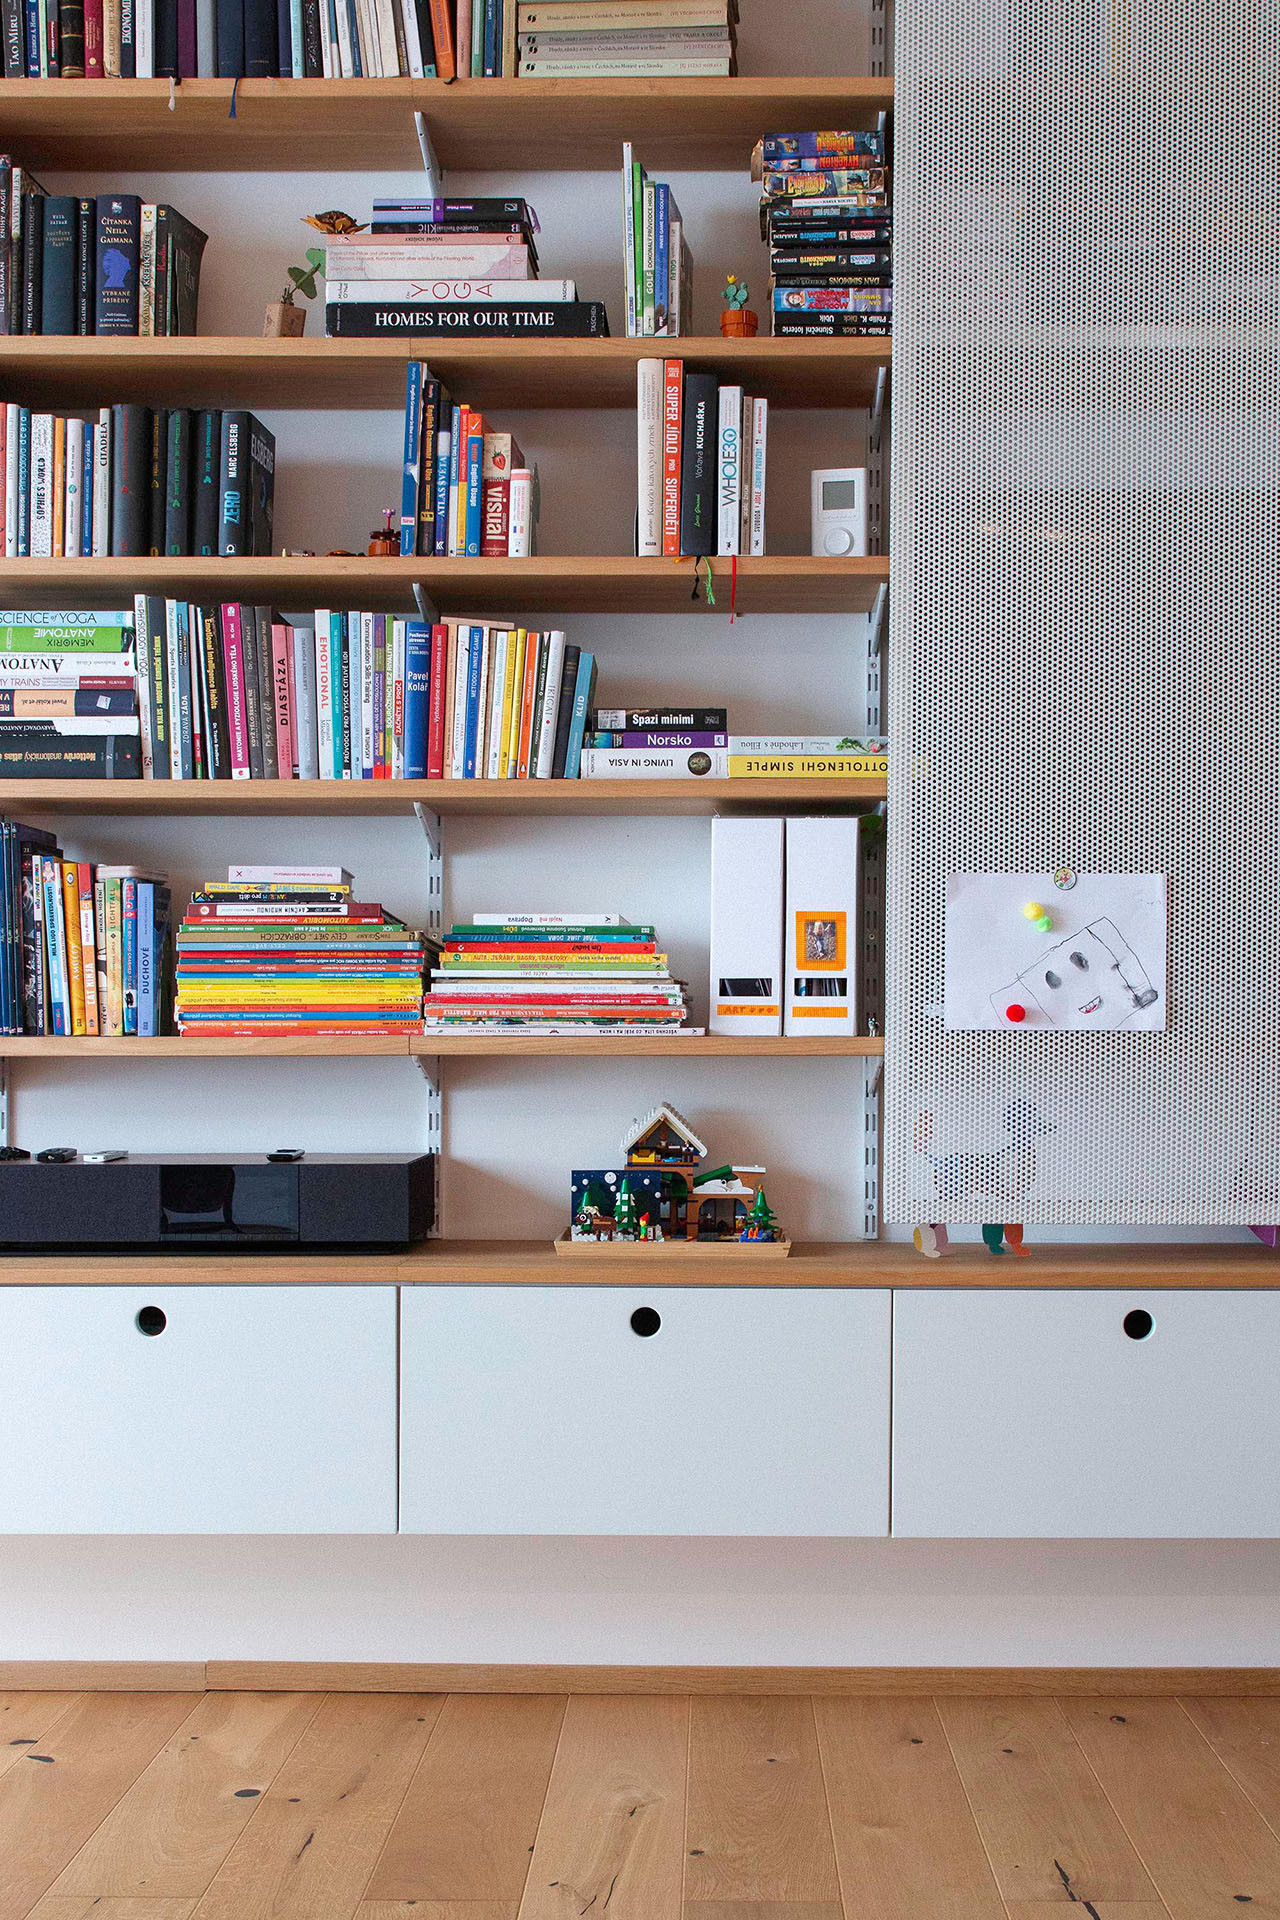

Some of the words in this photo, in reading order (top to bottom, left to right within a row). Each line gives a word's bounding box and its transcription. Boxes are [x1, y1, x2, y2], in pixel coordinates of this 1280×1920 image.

[8, 15, 18, 43] MÍRU
[10, 46, 19, 67] TAO
[101, 216, 132, 226] ČÍTANKA
[100, 236, 133, 244] GAIMANA
[83, 262, 87, 270] NA
[829, 277, 863, 285] SIMMONS
[864, 277, 880, 285] DAN
[411, 282, 493, 300] YOGA
[374, 312, 434, 327] HOMES
[438, 312, 469, 326] FOR
[474, 312, 509, 326] OUR
[512, 312, 554, 326] TIME
[782, 326, 804, 334] loterie
[806, 326, 833, 334] Sluneční
[868, 327, 885, 335] Philip
[666, 386, 679, 421] SUPER
[426, 405, 434, 428] English
[697, 401, 705, 449] KUCHAŘKA
[229, 424, 238, 455] ELSBERG
[425, 430, 434, 459] Grammar
[665, 424, 679, 453] JÍDLO
[229, 456, 237, 478] MARC
[439, 457, 447, 486] SVĚTA
[647, 449, 657, 487] kávových
[668, 459, 676, 471] PRO
[723, 428, 737, 506] WHOLE30
[425, 469, 433, 481] Use
[470, 464, 479, 486] English
[470, 488, 479, 507] Usage
[647, 489, 655, 516] Kouzlo
[665, 478, 679, 535] SUPERDĚTI
[224, 491, 241, 524] ZERO
[486, 486, 507, 540] visual
[0, 613, 49, 624] SCIENCE
[59, 613, 98, 624] YOGA
[33, 628, 96, 638] ANATOMIE
[138, 610, 146, 652] PHYSIOLOGY
[205, 618, 214, 651] Emotional
[47, 639, 95, 647] MEMORIX
[139, 656, 148, 678] YOGA
[207, 652, 216, 688] Intelligence
[231, 661, 239, 690] LIDSKÉHO
[319, 637, 329, 709] EMOTIONAL
[409, 671, 428, 680] Pavel
[10, 678, 40, 687] TRAINS
[277, 657, 288, 726] DIASTÁZA
[408, 682, 428, 691] Kolář
[209, 689, 217, 710] Habits
[234, 691, 242, 725] FYZIOLOGIE
[547, 685, 556, 716] IKIGAI
[576, 695, 585, 717] KLID
[632, 714, 659, 727] Spazi
[661, 714, 694, 725] minimi
[647, 734, 692, 746] Norsko
[769, 741, 804, 750] Lahodně
[24, 752, 62, 761] anatomický
[64, 752, 96, 761] Netterův
[608, 758, 629, 766] ASIA
[630, 758, 642, 766] IN
[643, 758, 674, 767] LIVING
[746, 761, 794, 772] SIMPLE
[801, 761, 888, 772] OTTOLENGHI
[109, 887, 117, 929] LIGHTFALL
[507, 916, 533, 924] Doprava
[314, 933, 330, 941] SVĚT
[331, 932, 347, 941] CELÝ
